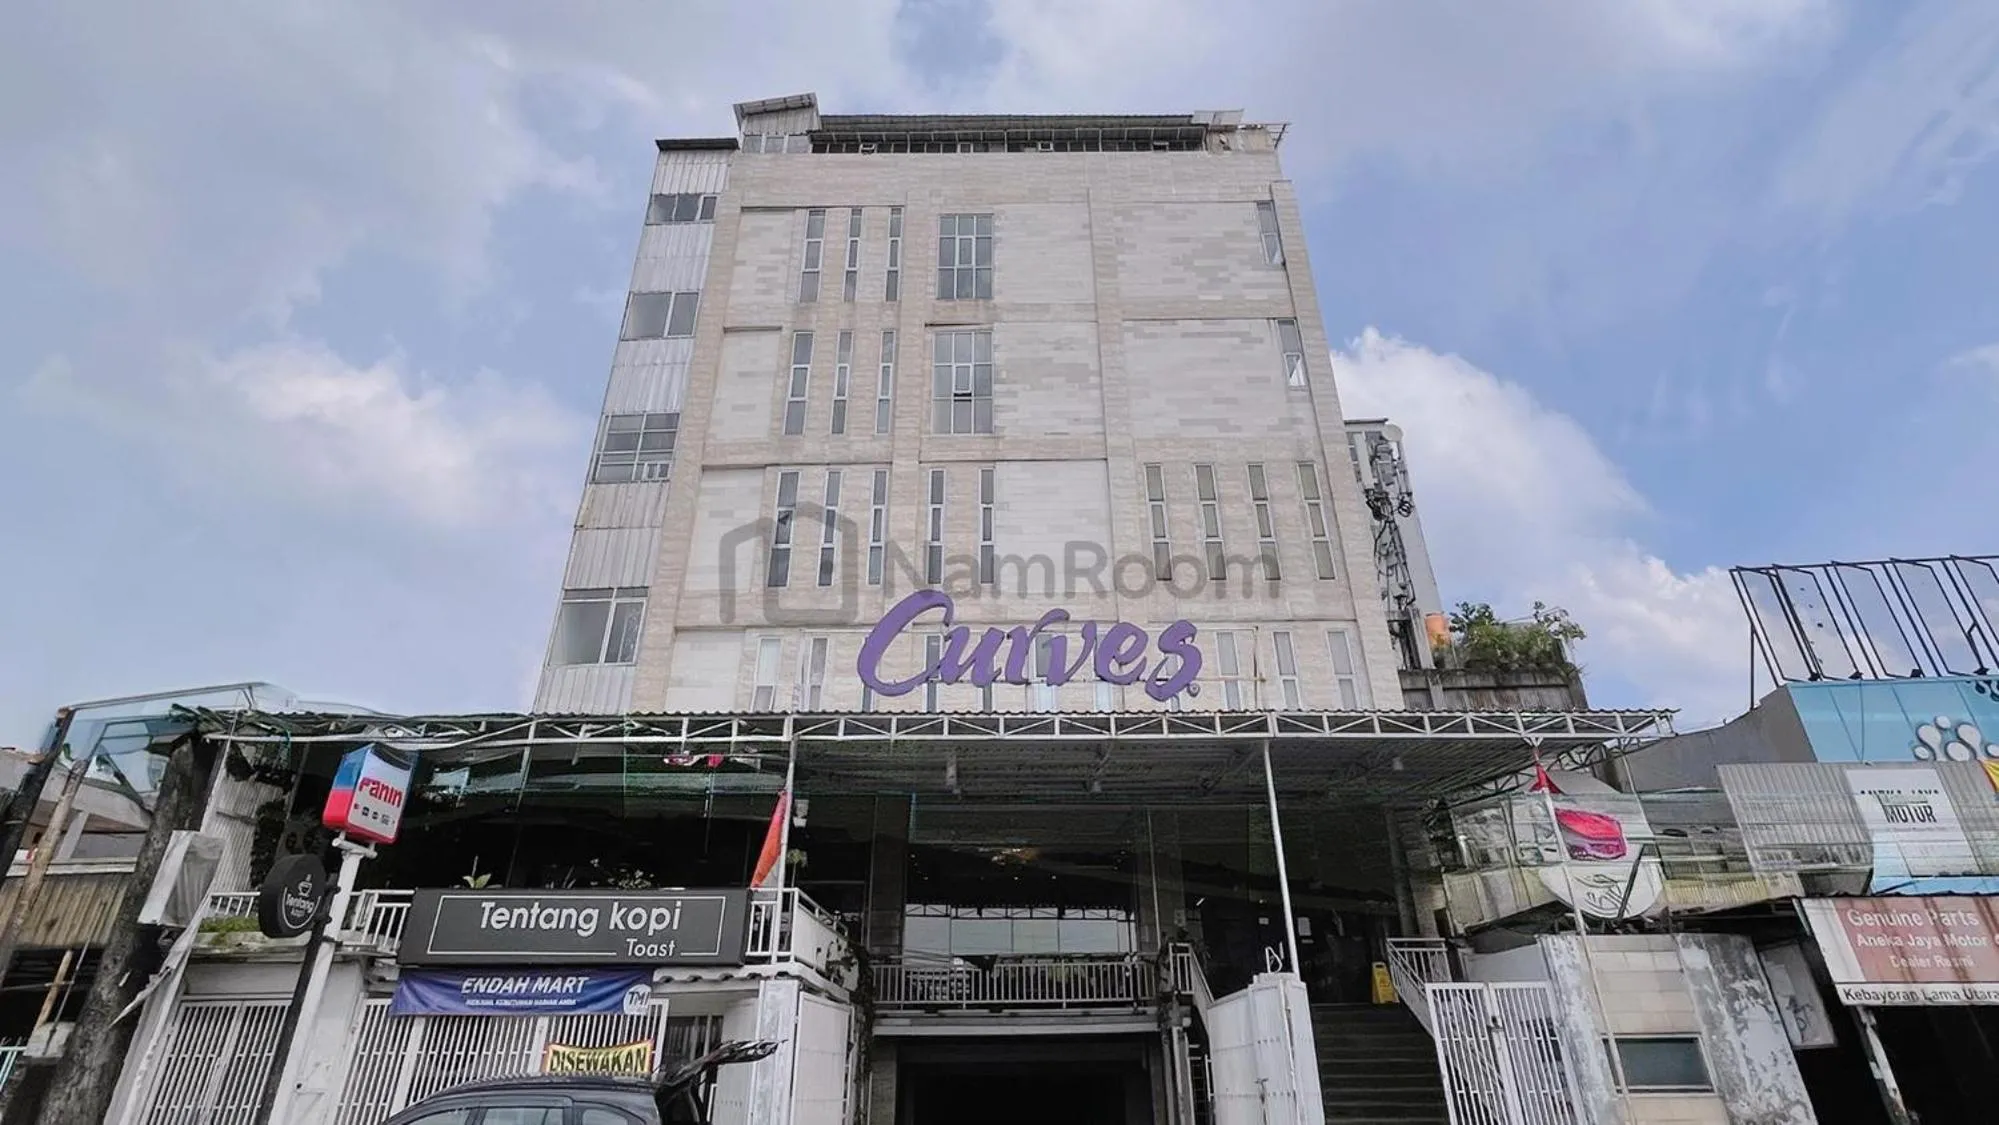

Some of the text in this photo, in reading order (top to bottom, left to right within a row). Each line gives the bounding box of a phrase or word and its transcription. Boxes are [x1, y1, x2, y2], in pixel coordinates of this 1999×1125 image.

[857, 589, 1203, 701] Curves
[480, 900, 682, 937] Tentang kopi
[1847, 908, 1980, 927] Genuine Parts
[625, 938, 676, 957] Toast
[1856, 933, 1903, 947] Aneka
[1906, 932, 1941, 950] Jaya
[460, 976, 590, 994] ENDAH MART
[1842, 987, 1920, 1004] Kebayoran
[1921, 987, 1961, 1002] Lama
[550, 1046, 648, 1073] DISEWAKAN
